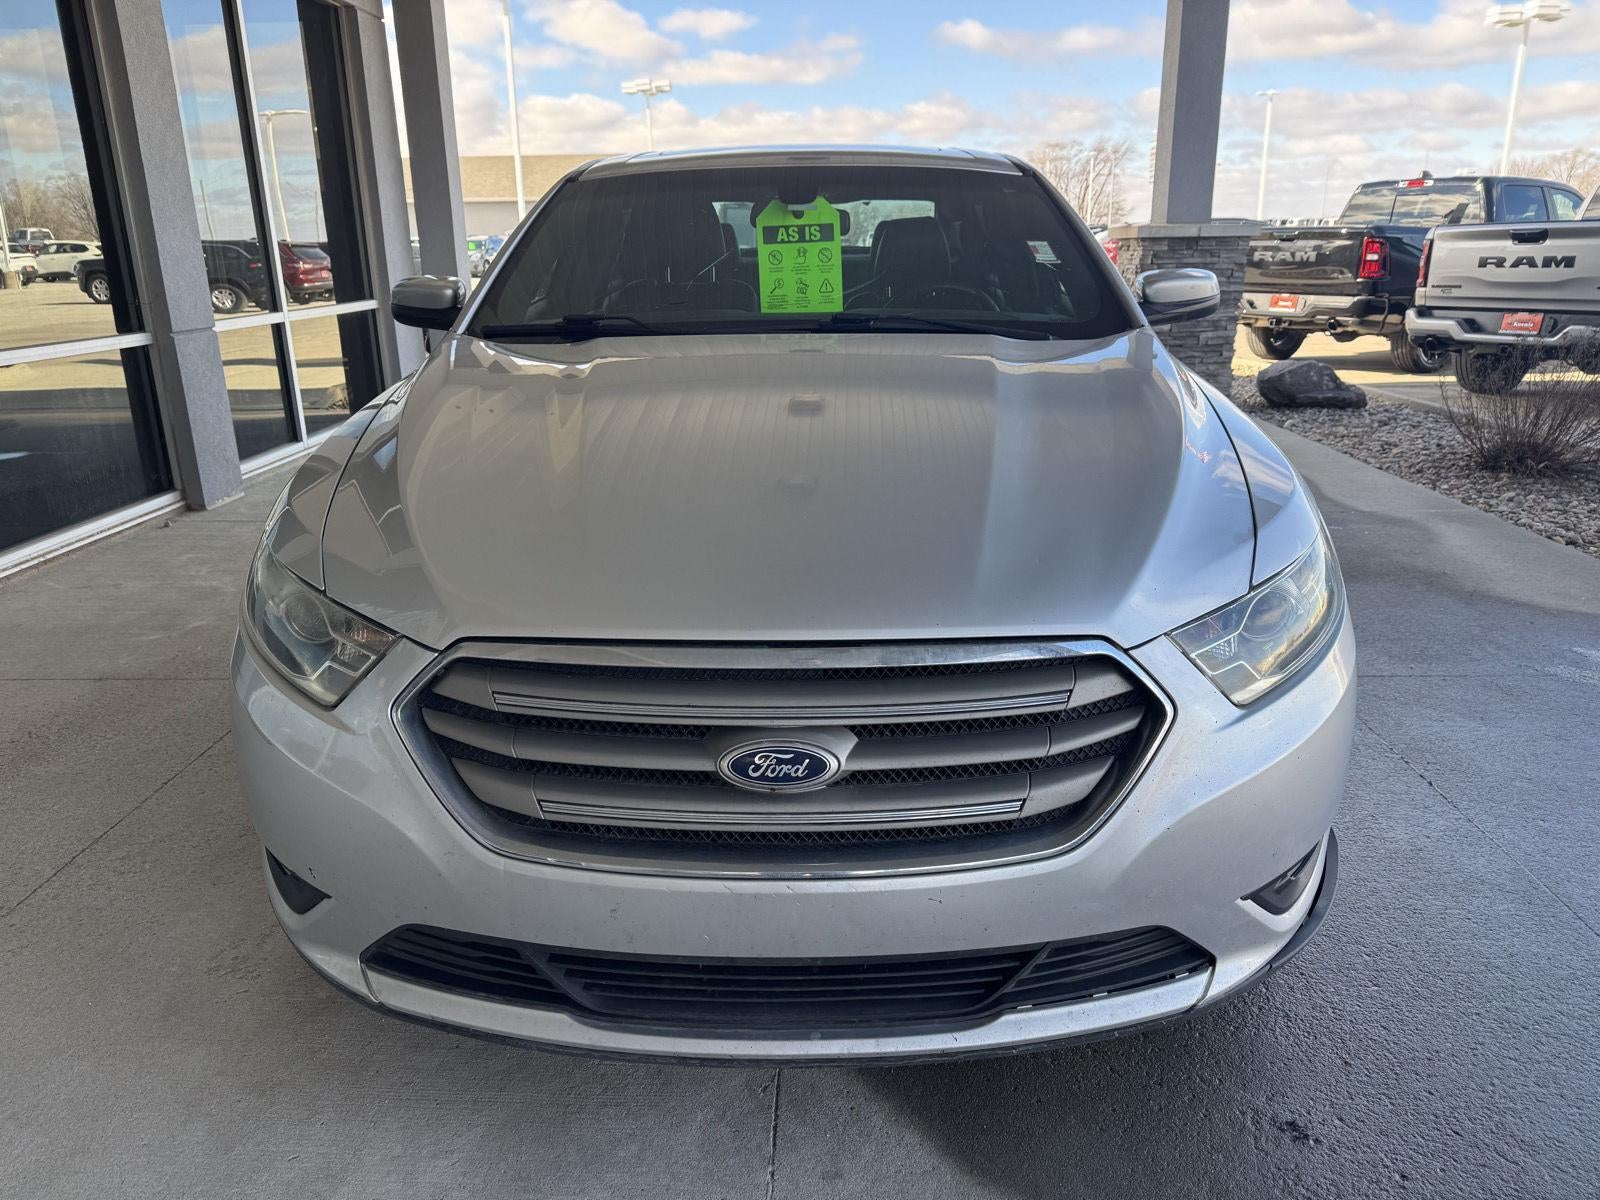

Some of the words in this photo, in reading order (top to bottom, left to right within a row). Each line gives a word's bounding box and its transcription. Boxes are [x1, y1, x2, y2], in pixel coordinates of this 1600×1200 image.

[777, 227, 799, 242] AS
[805, 225, 821, 240] IS
[1252, 250, 1318, 263] RAM
[1477, 255, 1577, 269] RAM
[747, 752, 810, 778] Ford
